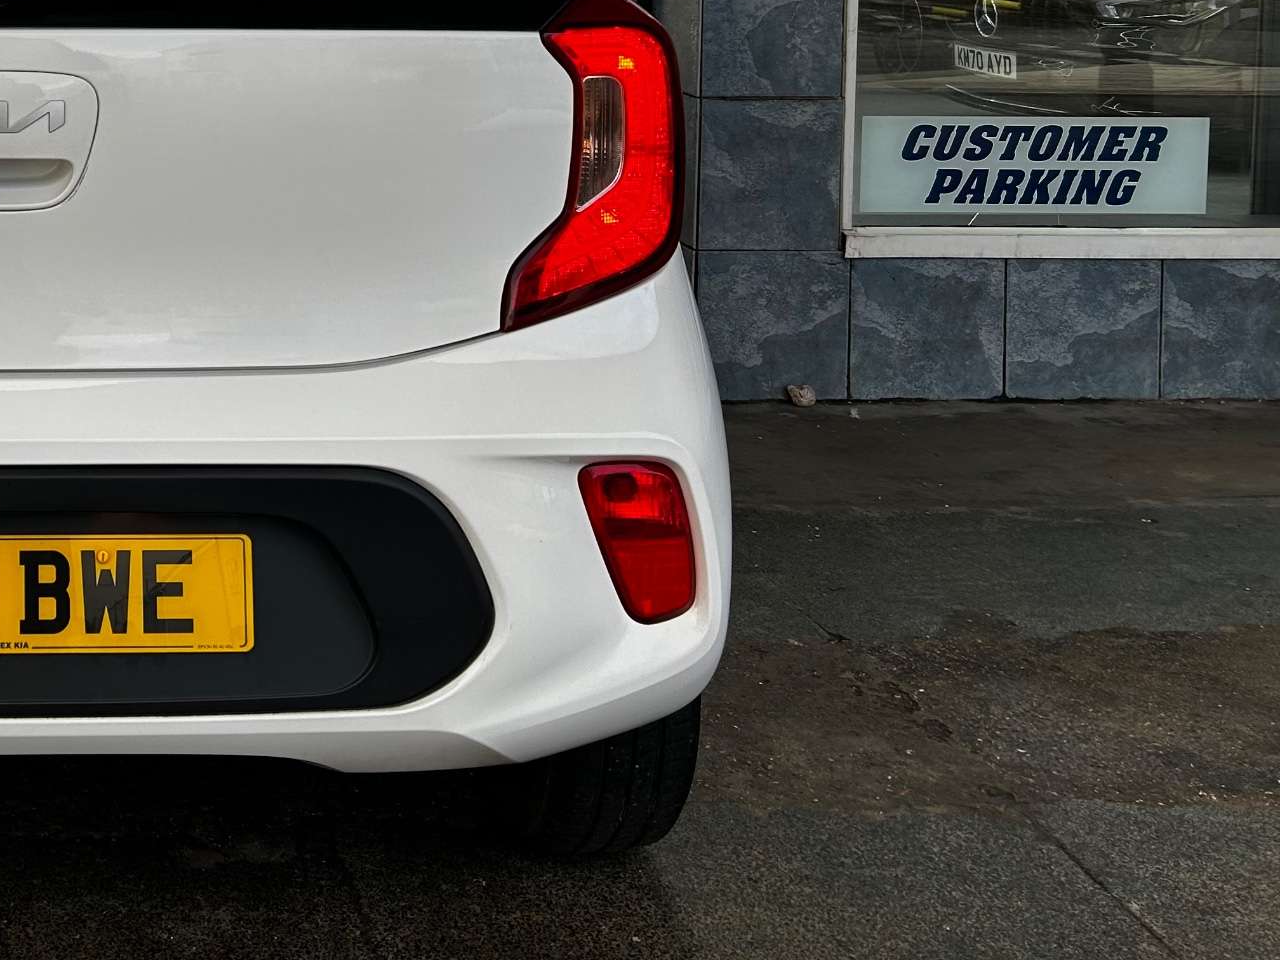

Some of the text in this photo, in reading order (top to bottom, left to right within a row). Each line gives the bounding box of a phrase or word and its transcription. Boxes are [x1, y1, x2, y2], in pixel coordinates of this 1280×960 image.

[987, 53, 1012, 76] AYD
[901, 124, 1169, 162] CUSTOMER
[924, 168, 1142, 206] PARKING
[18, 549, 195, 635] BWE
